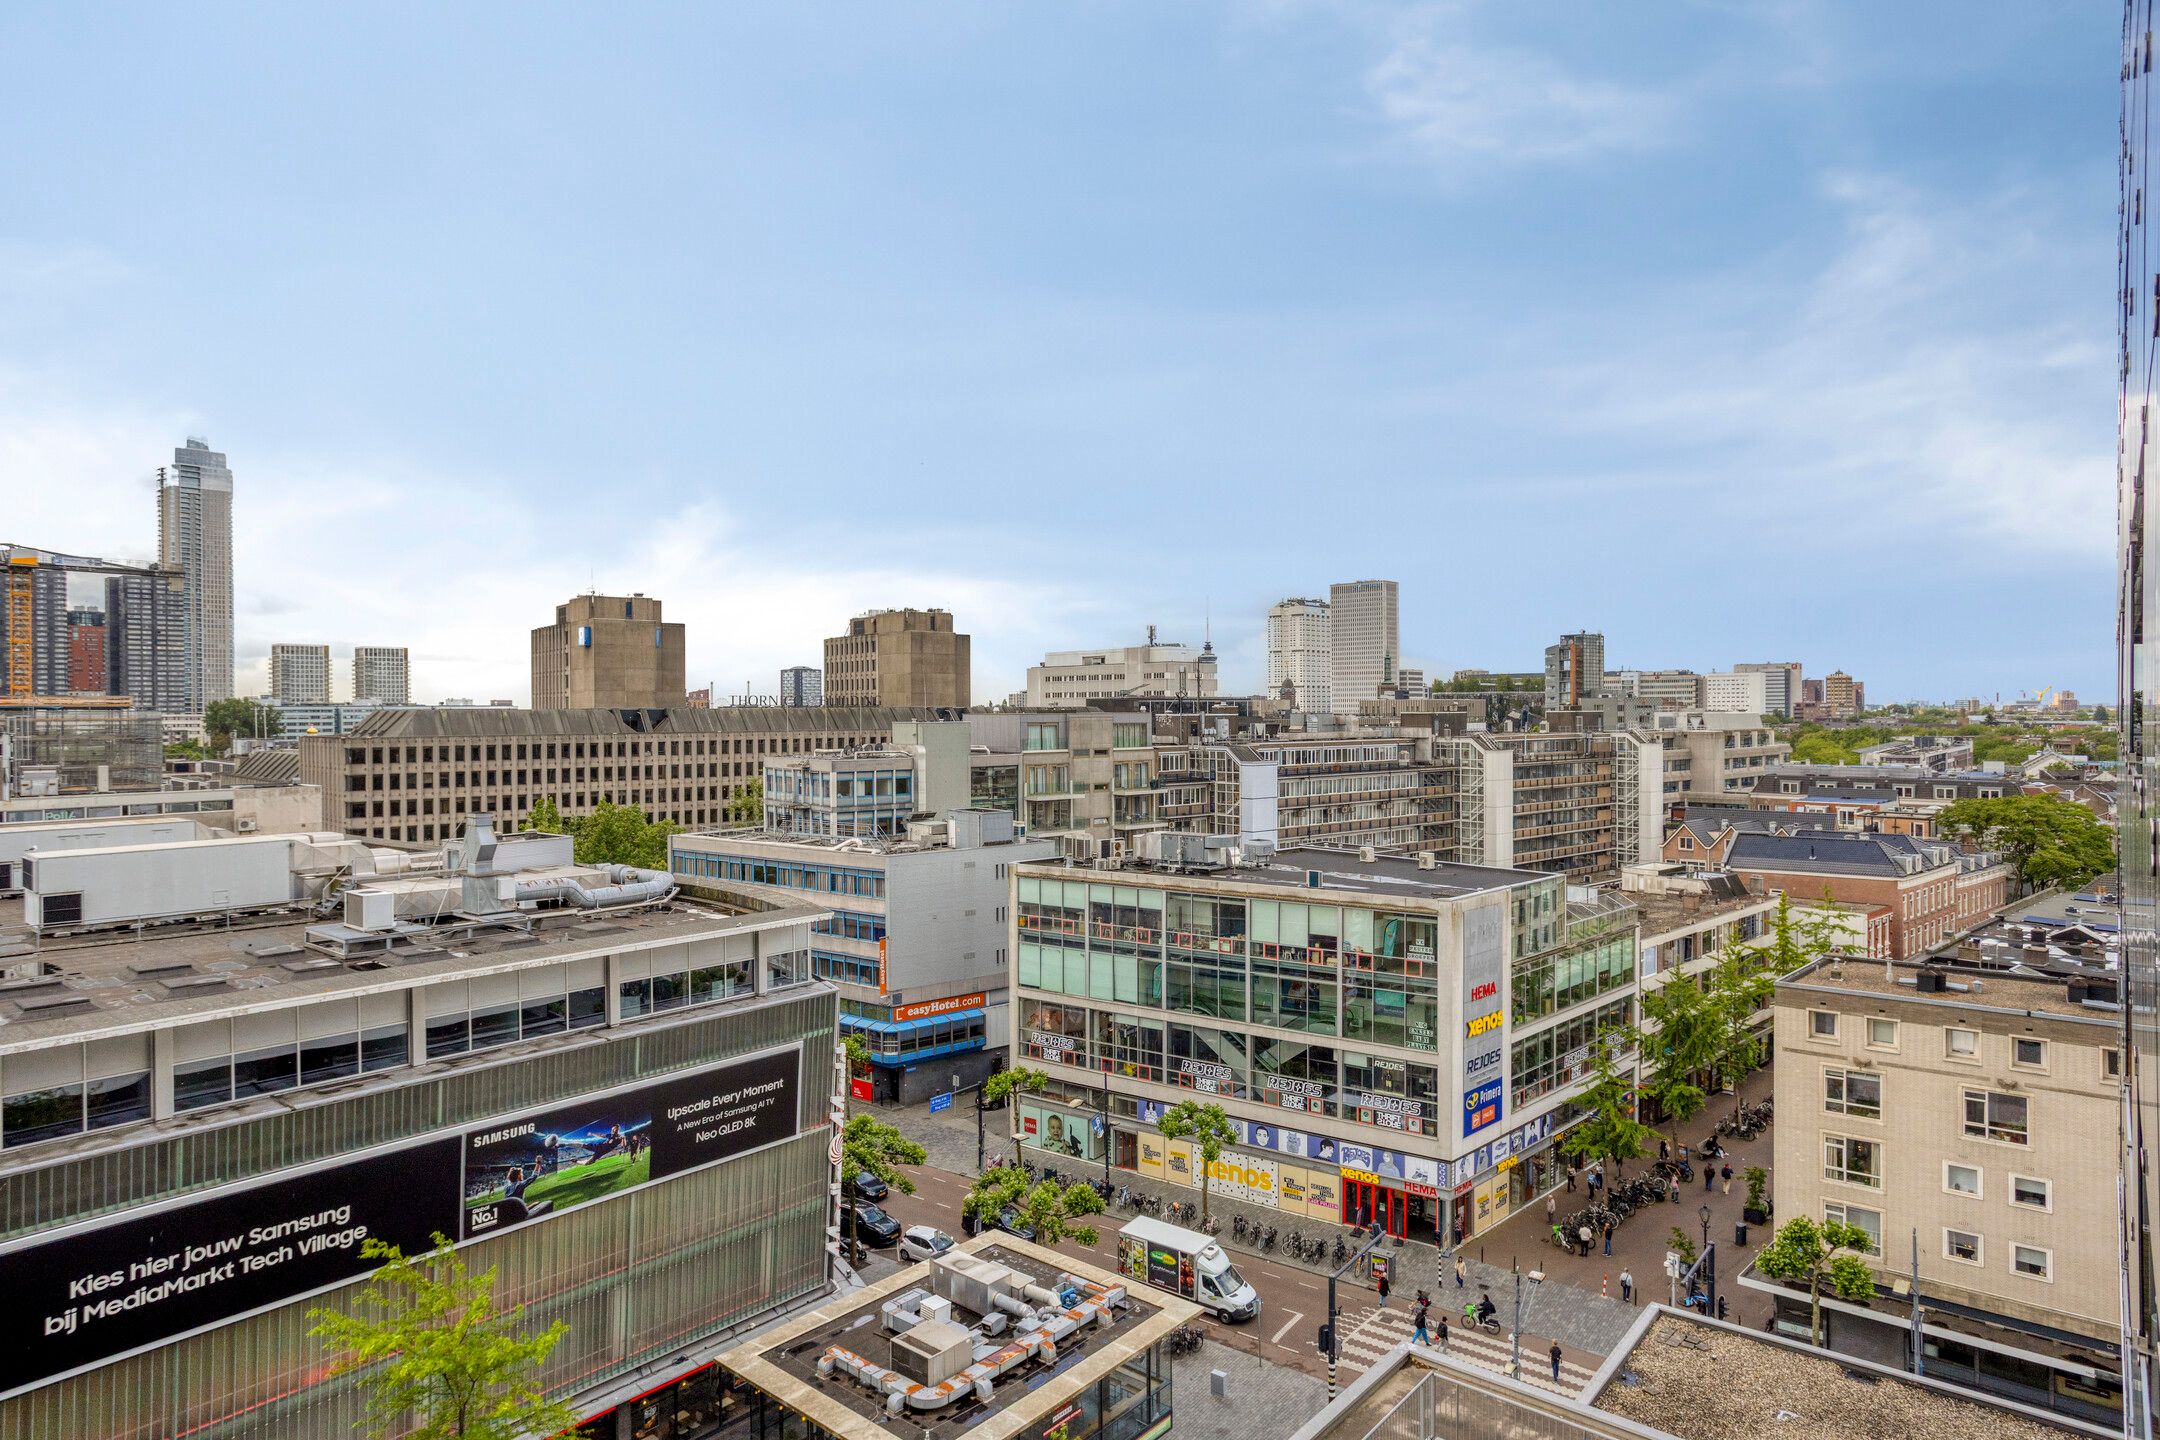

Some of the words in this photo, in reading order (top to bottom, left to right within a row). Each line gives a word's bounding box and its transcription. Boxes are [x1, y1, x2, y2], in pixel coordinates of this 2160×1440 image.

[1471, 981, 1496, 1002] HEMA
[907, 996, 981, 1017] easyHotel.com
[1466, 1010, 1504, 1038] xenos
[1031, 1031, 1075, 1050] REJOES
[1181, 1059, 1232, 1080] REJOES
[1374, 1060, 1405, 1071] REJOES
[1466, 1048, 1501, 1074] REJOES
[1195, 1077, 1216, 1087] THRIFT
[1266, 1075, 1322, 1097] REJOES
[667, 1100, 710, 1120] Upscale
[712, 1091, 741, 1107] Every
[743, 1078, 784, 1098] Moment
[1282, 1093, 1304, 1104] THRIFT
[1360, 1093, 1421, 1116] REJOES
[1480, 1085, 1501, 1104] Primera
[677, 1124, 682, 1132] A
[684, 1119, 700, 1130] New
[702, 1116, 714, 1124] Era
[724, 1102, 757, 1118] Samsung
[1376, 1111, 1402, 1122] THRIFT
[473, 1123, 535, 1148] SAMSUNG
[695, 1130, 717, 1143] Neo
[718, 1120, 743, 1136] QLED
[744, 1116, 757, 1128] 8K
[1200, 1158, 1272, 1191] xenos
[1340, 1166, 1380, 1184] xenos
[1497, 1155, 1518, 1174] xenos
[1404, 1181, 1438, 1196] HEMA
[1454, 1180, 1473, 1195] HEMA
[472, 1205, 490, 1214] Global
[472, 1207, 498, 1225] No.1
[69, 1270, 124, 1299] Kies
[129, 1252, 179, 1281] hier
[182, 1235, 244, 1271] jouw
[248, 1204, 351, 1246] Samsung
[44, 1311, 77, 1336] bij
[83, 1261, 235, 1324] MediaMarkt
[239, 1246, 293, 1274] Tech
[298, 1225, 368, 1256] Village
